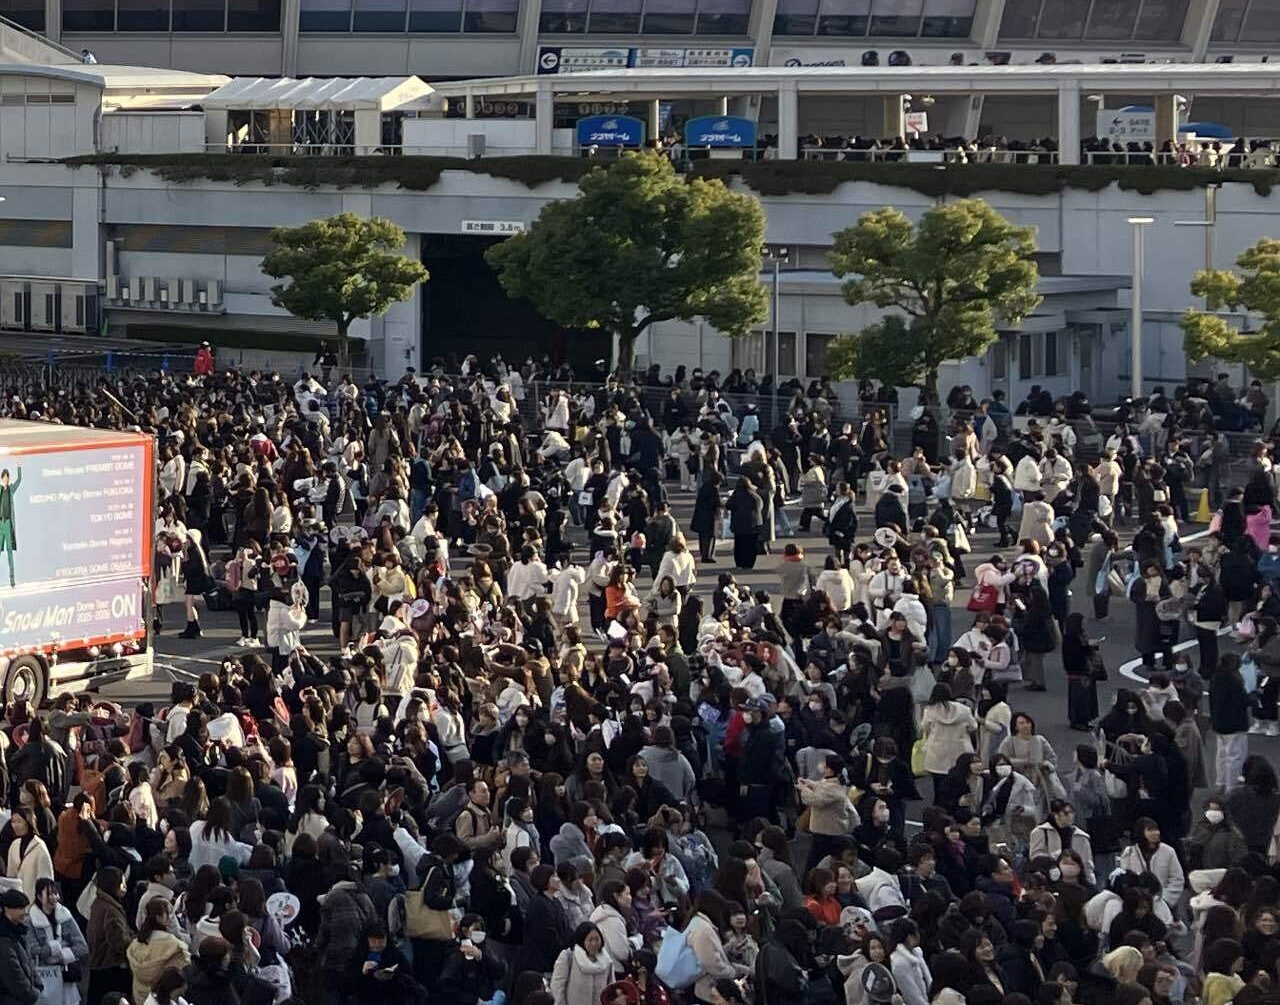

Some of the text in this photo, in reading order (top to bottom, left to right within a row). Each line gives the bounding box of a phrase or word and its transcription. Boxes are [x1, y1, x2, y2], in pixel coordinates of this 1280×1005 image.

[76, 599, 109, 612] Dome Tour
[111, 593, 137, 619] ON
[0, 604, 76, 634] Snow Man
